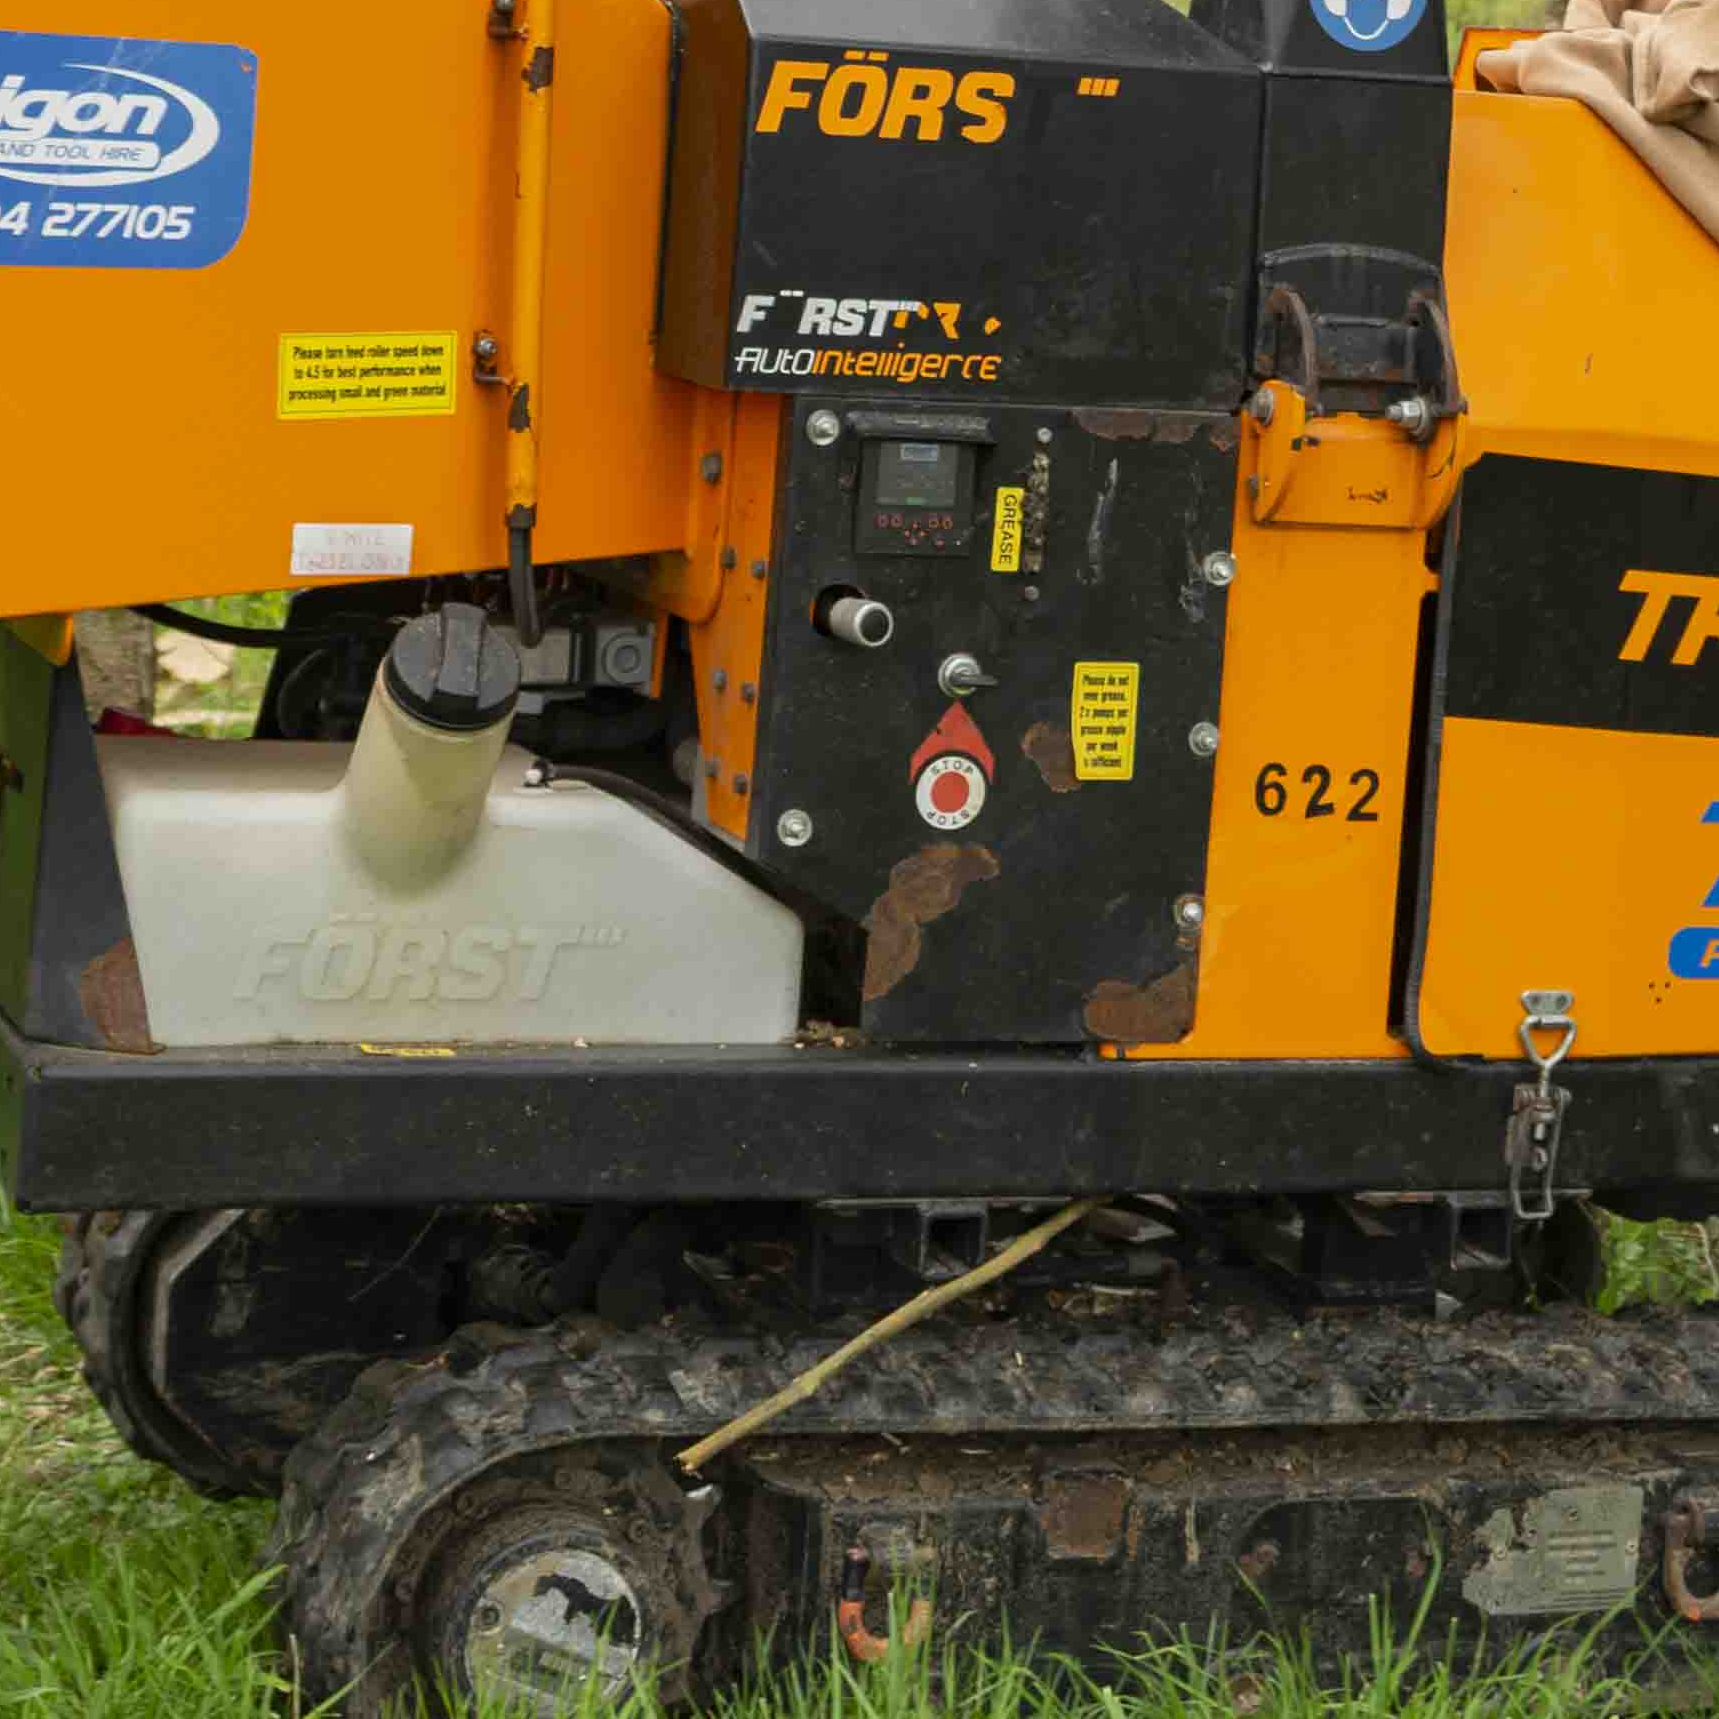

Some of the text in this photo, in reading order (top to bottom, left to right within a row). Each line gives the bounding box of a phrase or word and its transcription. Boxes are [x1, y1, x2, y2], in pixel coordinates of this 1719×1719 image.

[43, 144, 90, 160] TOOL
[98, 146, 145, 162] HIRE
[41, 202, 196, 241] 277105
[737, 290, 901, 337] FRST
[998, 493, 1017, 565] GREASE
[930, 761, 973, 774] STOP
[1255, 762, 1380, 822] 622
[926, 809, 970, 825] STOP
[232, 912, 581, 1002] FÖRST
